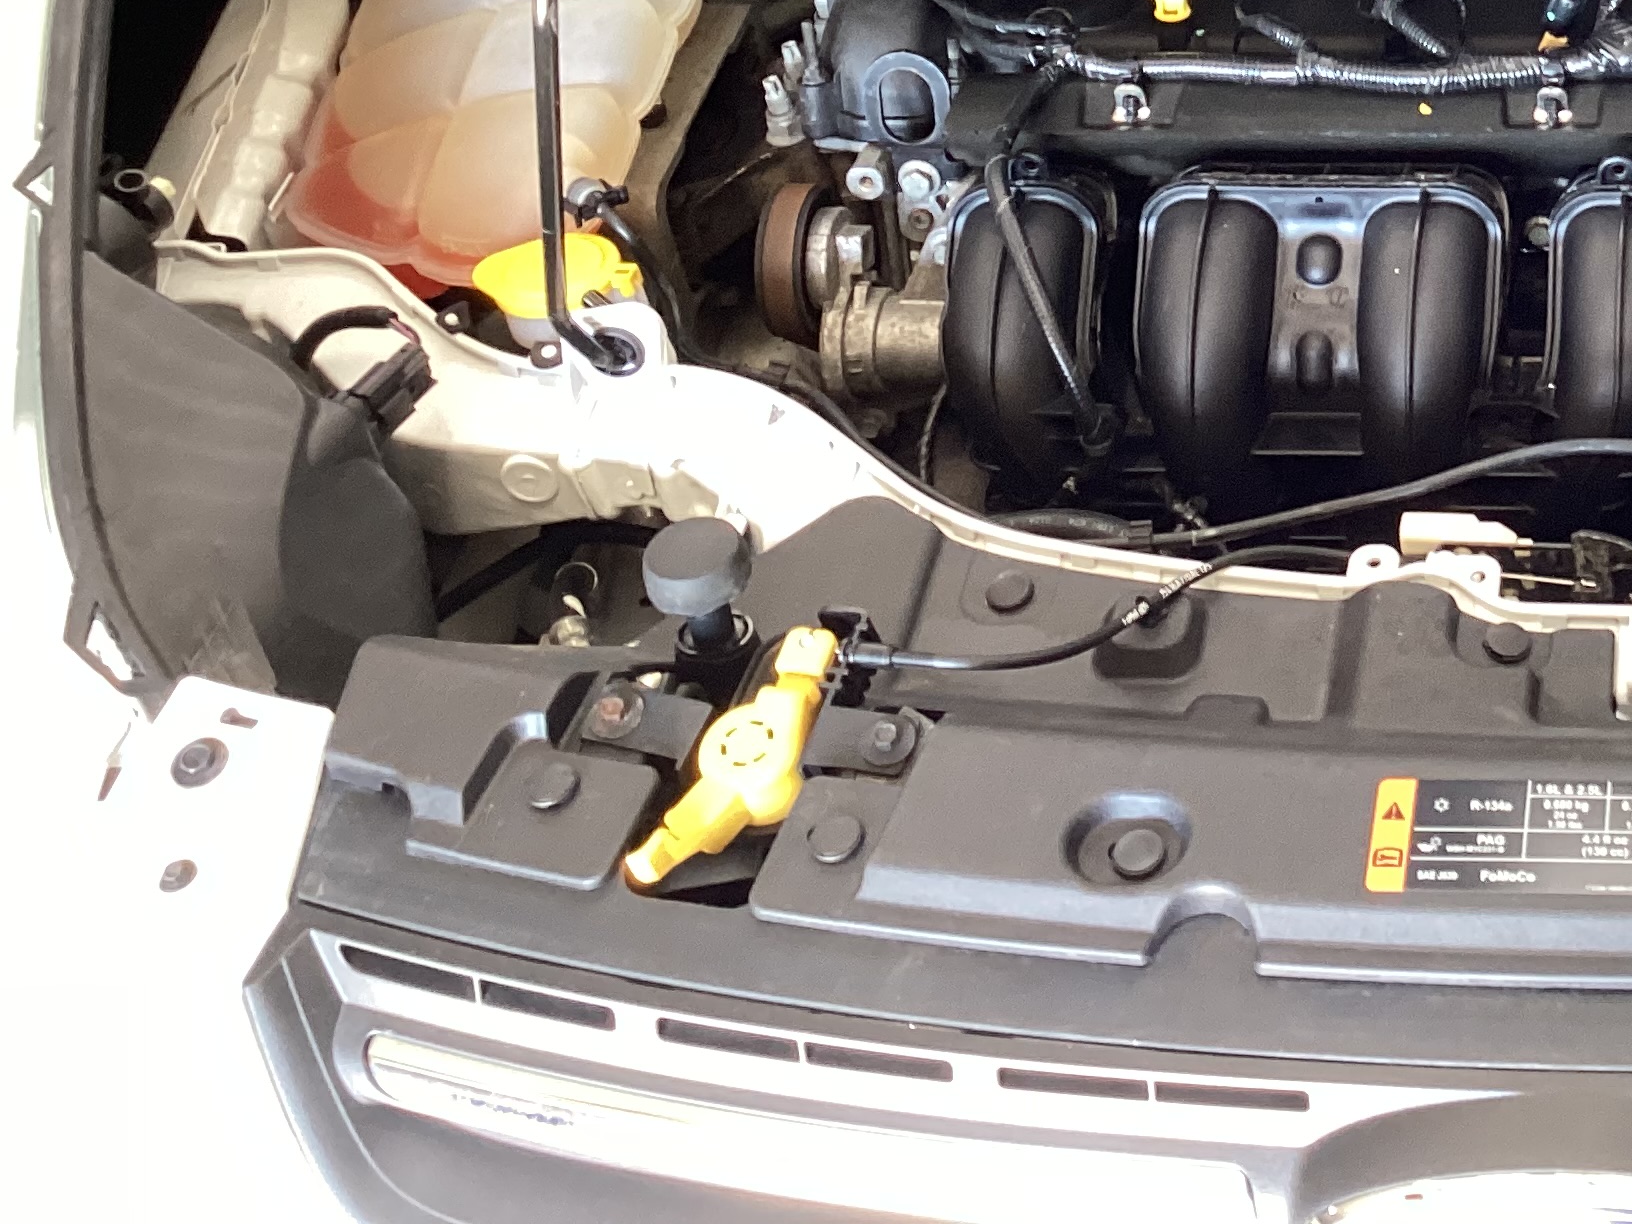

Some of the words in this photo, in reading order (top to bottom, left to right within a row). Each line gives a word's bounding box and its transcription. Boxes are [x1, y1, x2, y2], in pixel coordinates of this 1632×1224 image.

[1469, 798, 1515, 811] R-134a
[1574, 800, 1589, 813] kg
[1476, 833, 1506, 845] PAG
